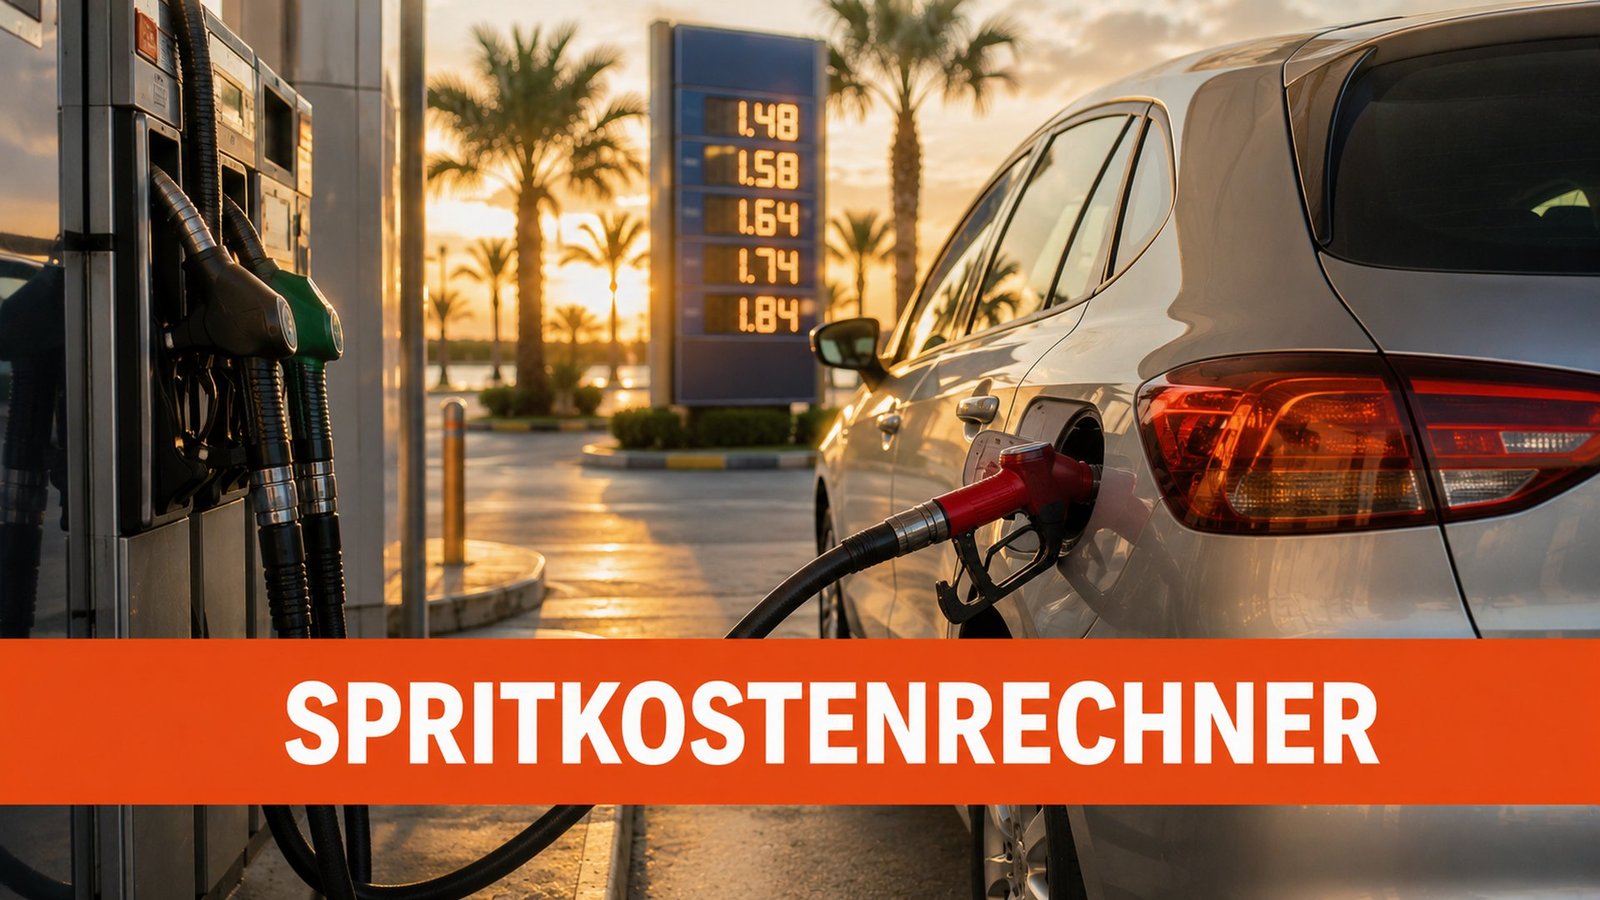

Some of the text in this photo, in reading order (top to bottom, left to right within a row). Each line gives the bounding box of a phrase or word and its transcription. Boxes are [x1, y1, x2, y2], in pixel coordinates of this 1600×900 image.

[738, 100, 799, 142] 1.48
[738, 149, 799, 190] 1.58
[738, 198, 799, 237] 1.64
[738, 247, 799, 285] 1.74
[738, 295, 799, 333] 1.84
